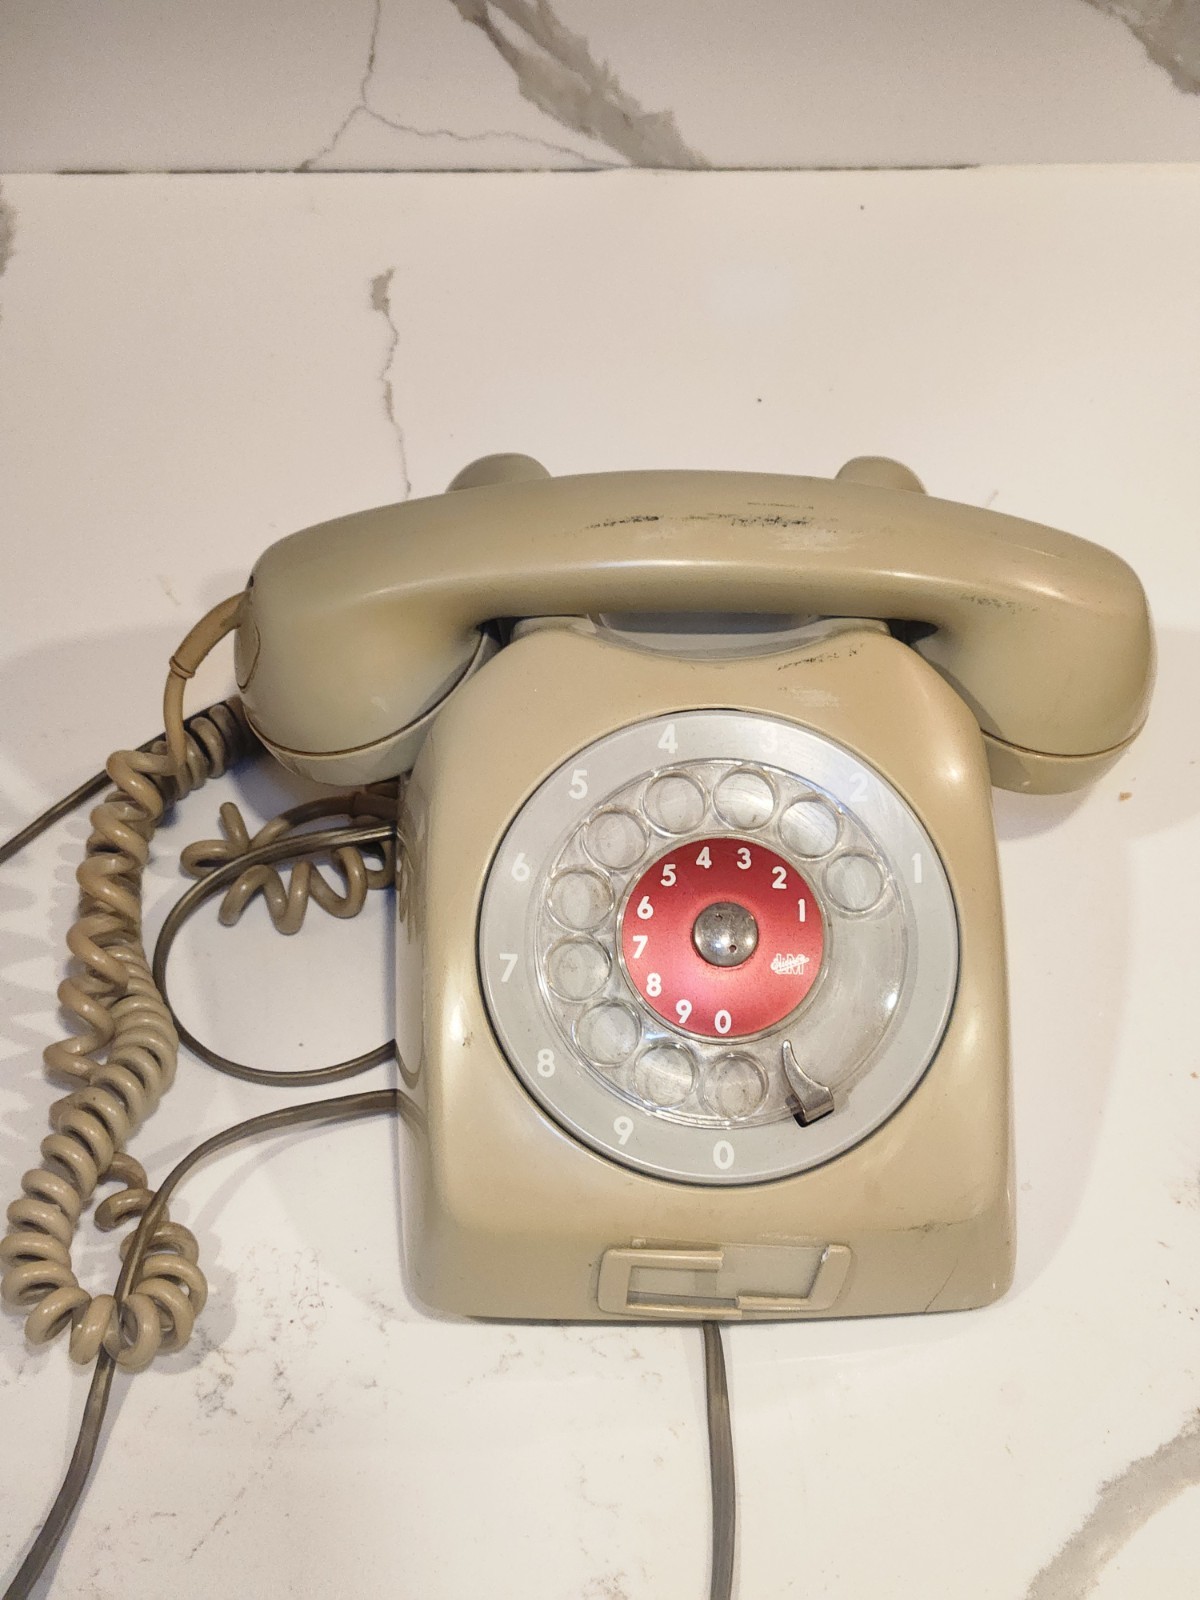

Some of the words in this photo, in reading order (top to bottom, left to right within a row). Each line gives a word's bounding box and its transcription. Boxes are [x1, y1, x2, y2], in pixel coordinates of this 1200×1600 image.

[657, 723, 679, 754] 4
[760, 726, 779, 752] 3
[568, 769, 588, 799] 5
[850, 772, 870, 802] 2
[511, 853, 531, 882] 6
[695, 846, 712, 869] 4
[737, 847, 752, 870] 3
[911, 853, 923, 883] 1
[660, 864, 676, 887] 5
[771, 866, 787, 889] 2
[637, 896, 654, 920] 6
[797, 899, 806, 922] 1
[632, 935, 648, 959] 7
[499, 954, 518, 982] 7
[646, 973, 662, 997] 8
[676, 999, 692, 1024] 9
[714, 1009, 732, 1034] 0
[536, 1048, 556, 1078] 8
[613, 1117, 634, 1146] 9
[713, 1141, 735, 1171] 0
